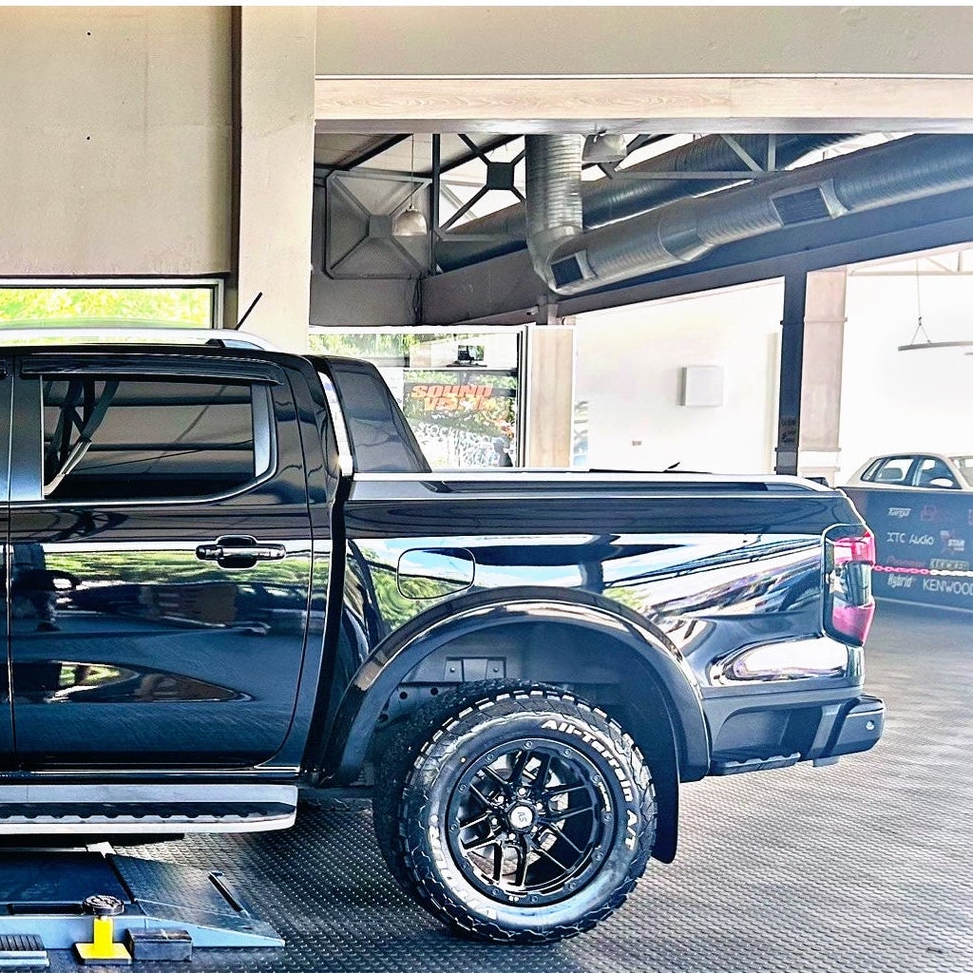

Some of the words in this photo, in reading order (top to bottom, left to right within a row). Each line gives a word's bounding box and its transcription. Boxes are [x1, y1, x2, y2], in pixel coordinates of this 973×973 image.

[410, 384, 494, 398] SOUND
[540, 718, 634, 803] All-Terrain
[624, 808, 638, 851] A/T
